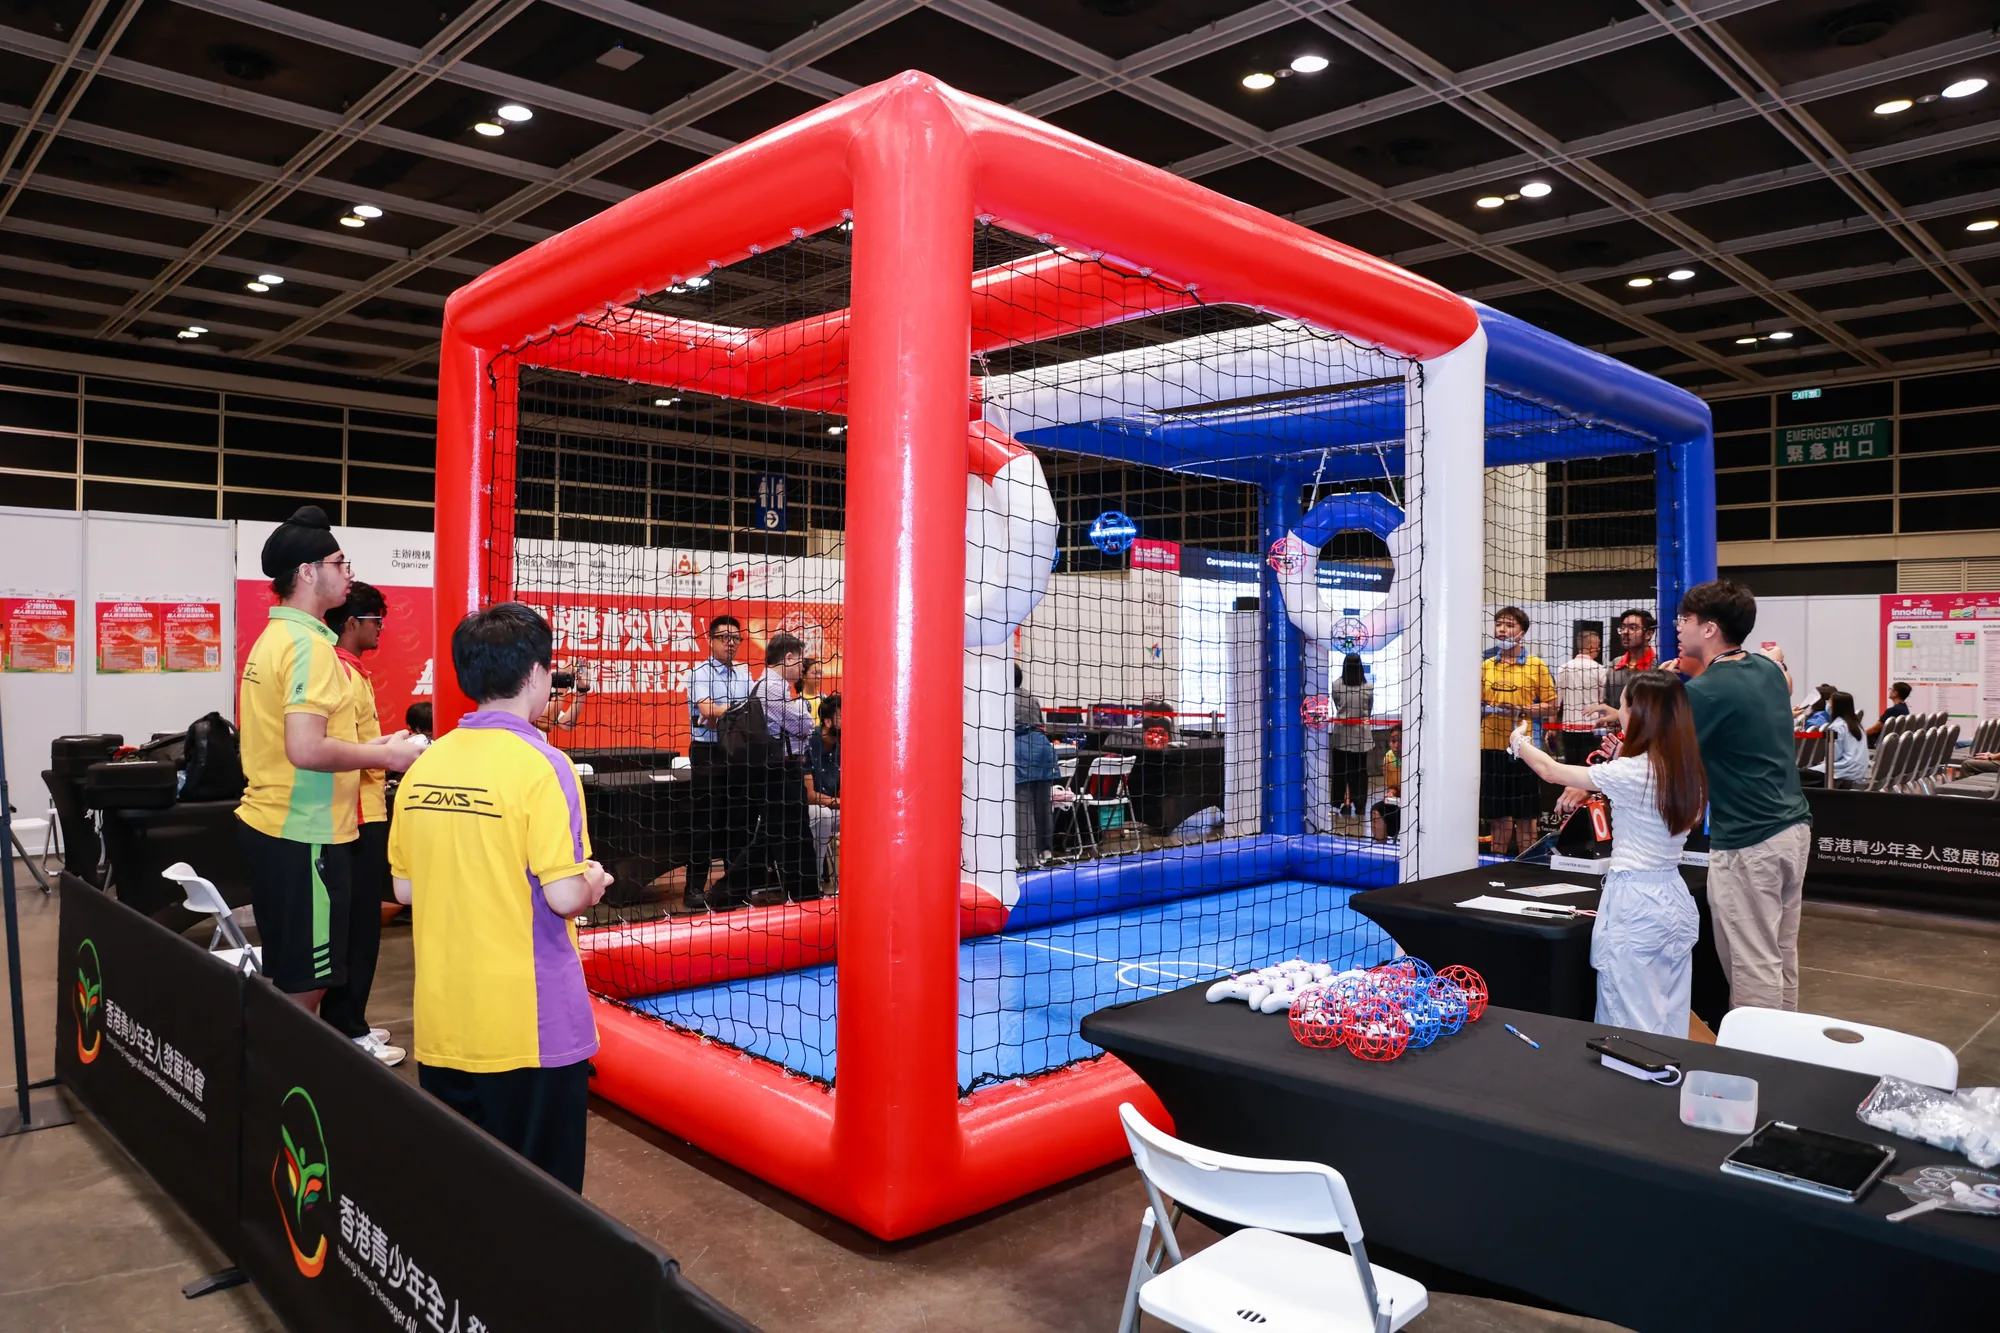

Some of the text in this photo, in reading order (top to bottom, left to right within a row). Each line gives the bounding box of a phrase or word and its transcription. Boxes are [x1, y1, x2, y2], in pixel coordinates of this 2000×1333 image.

[1786, 422, 1875, 442] EMERGENCY EXIT
[1786, 440, 1874, 462] 緊急出口
[391, 560, 429, 569] Organizer
[392, 549, 431, 560] 主辦機構
[530, 606, 700, 653] 港校際
[422, 791, 470, 807] DMS
[1817, 837, 2000, 868] 香港青少年全人發展協
[1817, 853, 2000, 878] Hong Kong Teenager All-round Development Associa
[106, 999, 206, 1102] 香港青少年全人發展協會
